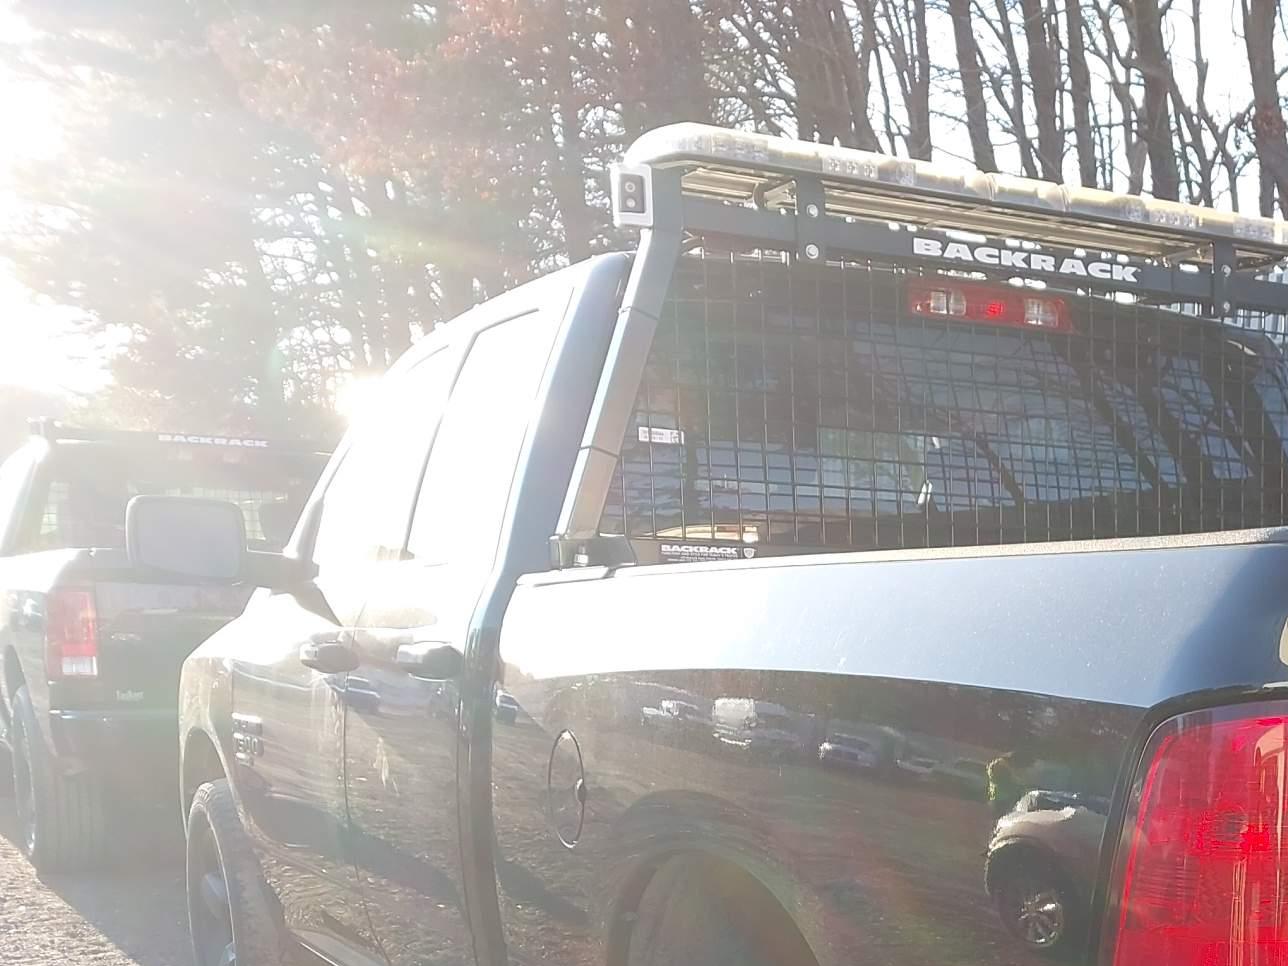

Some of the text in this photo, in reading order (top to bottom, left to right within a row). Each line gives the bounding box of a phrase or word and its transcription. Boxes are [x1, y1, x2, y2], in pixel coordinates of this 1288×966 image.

[912, 236, 1140, 283] BACKRACK
[158, 433, 270, 448] BACKRACK
[661, 544, 738, 555] BACKRACK
